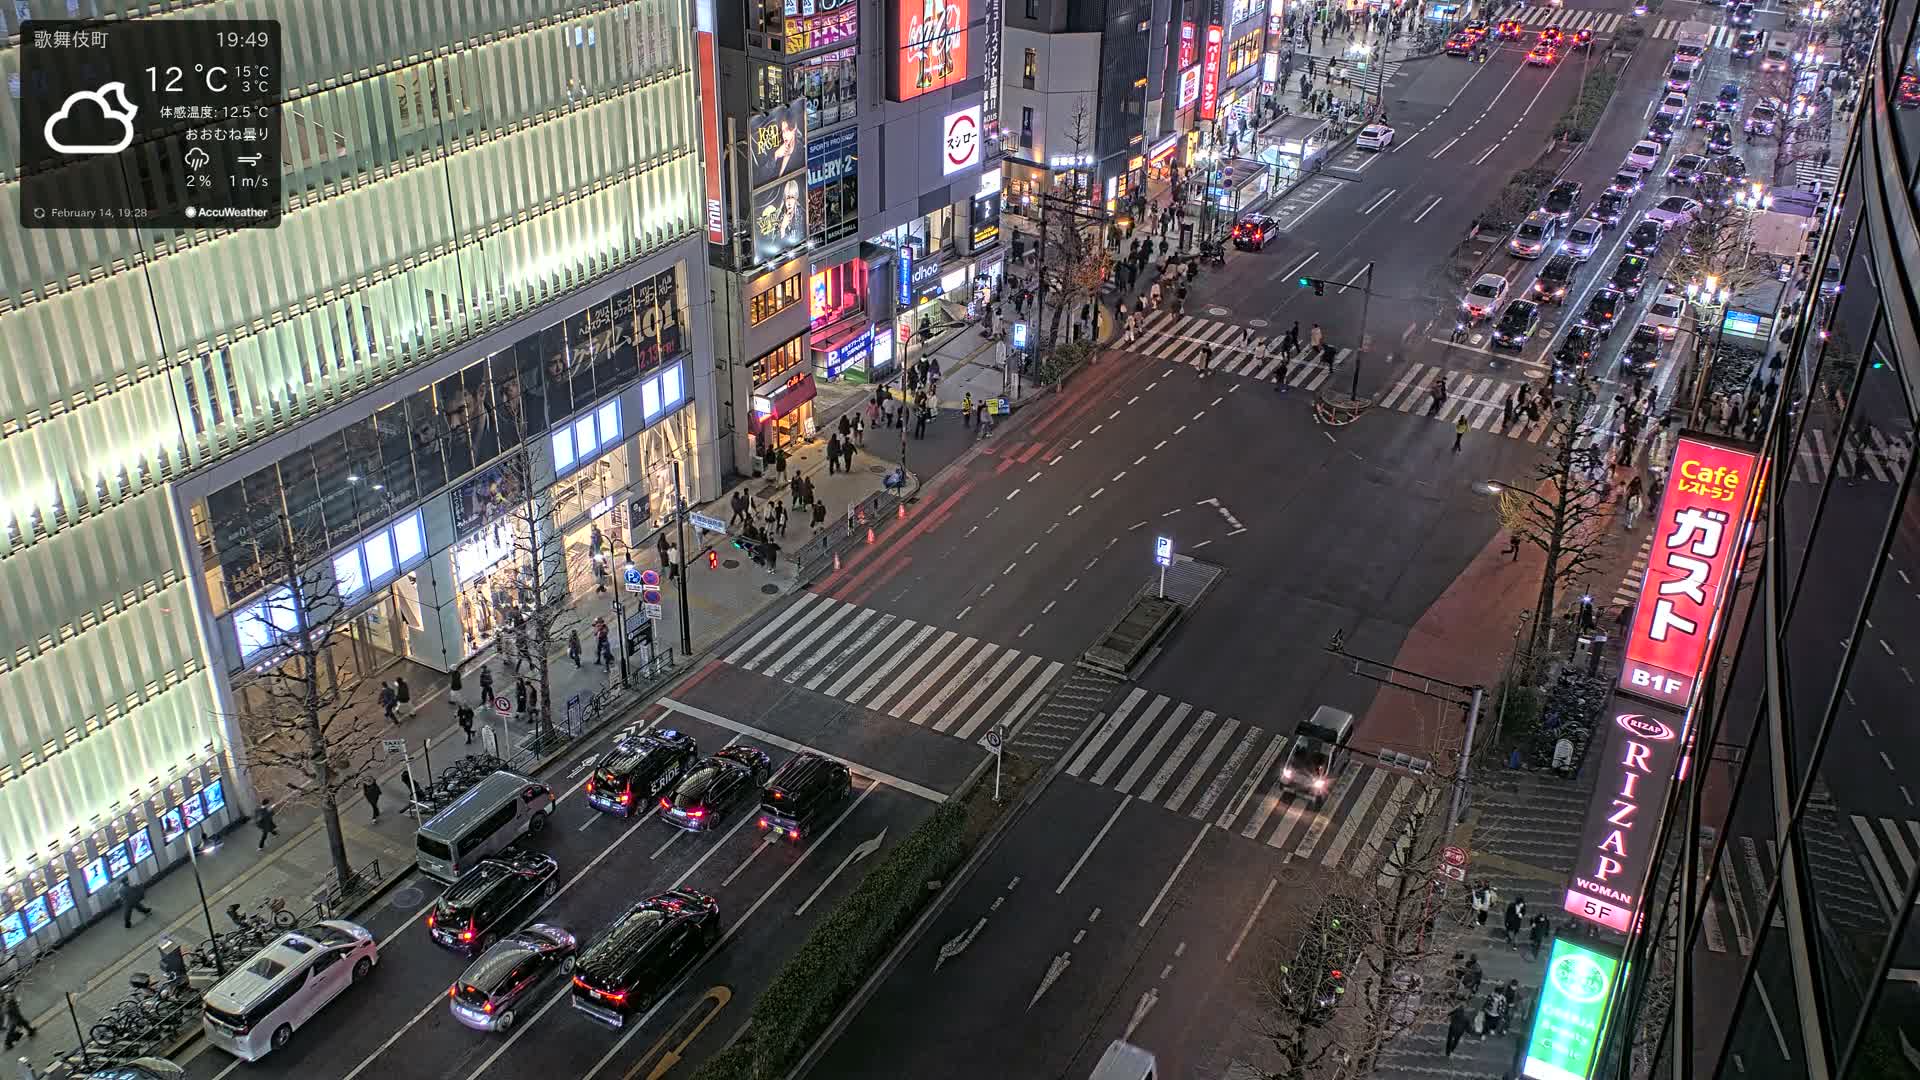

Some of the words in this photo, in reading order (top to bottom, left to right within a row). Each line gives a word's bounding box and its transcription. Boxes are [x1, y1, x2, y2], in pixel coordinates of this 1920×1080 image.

[1204, 45, 1218, 110] バーガーキング
[809, 141, 829, 154] SPORTS
[830, 137, 841, 148] PRO
[841, 133, 855, 144] SHOP
[947, 132, 977, 150] スシロー
[708, 199, 721, 233] MUJI
[1681, 459, 1740, 489] Café
[1678, 480, 1735, 501] レストラン
[1160, 539, 1168, 548] P
[1649, 509, 1727, 641] ガスト
[1632, 668, 1683, 694] B1F
[1630, 719, 1661, 735] RIZAP
[1594, 740, 1652, 881] RIZAP
[1577, 877, 1632, 904] WOMAN
[1583, 902, 1612, 921] 5F
